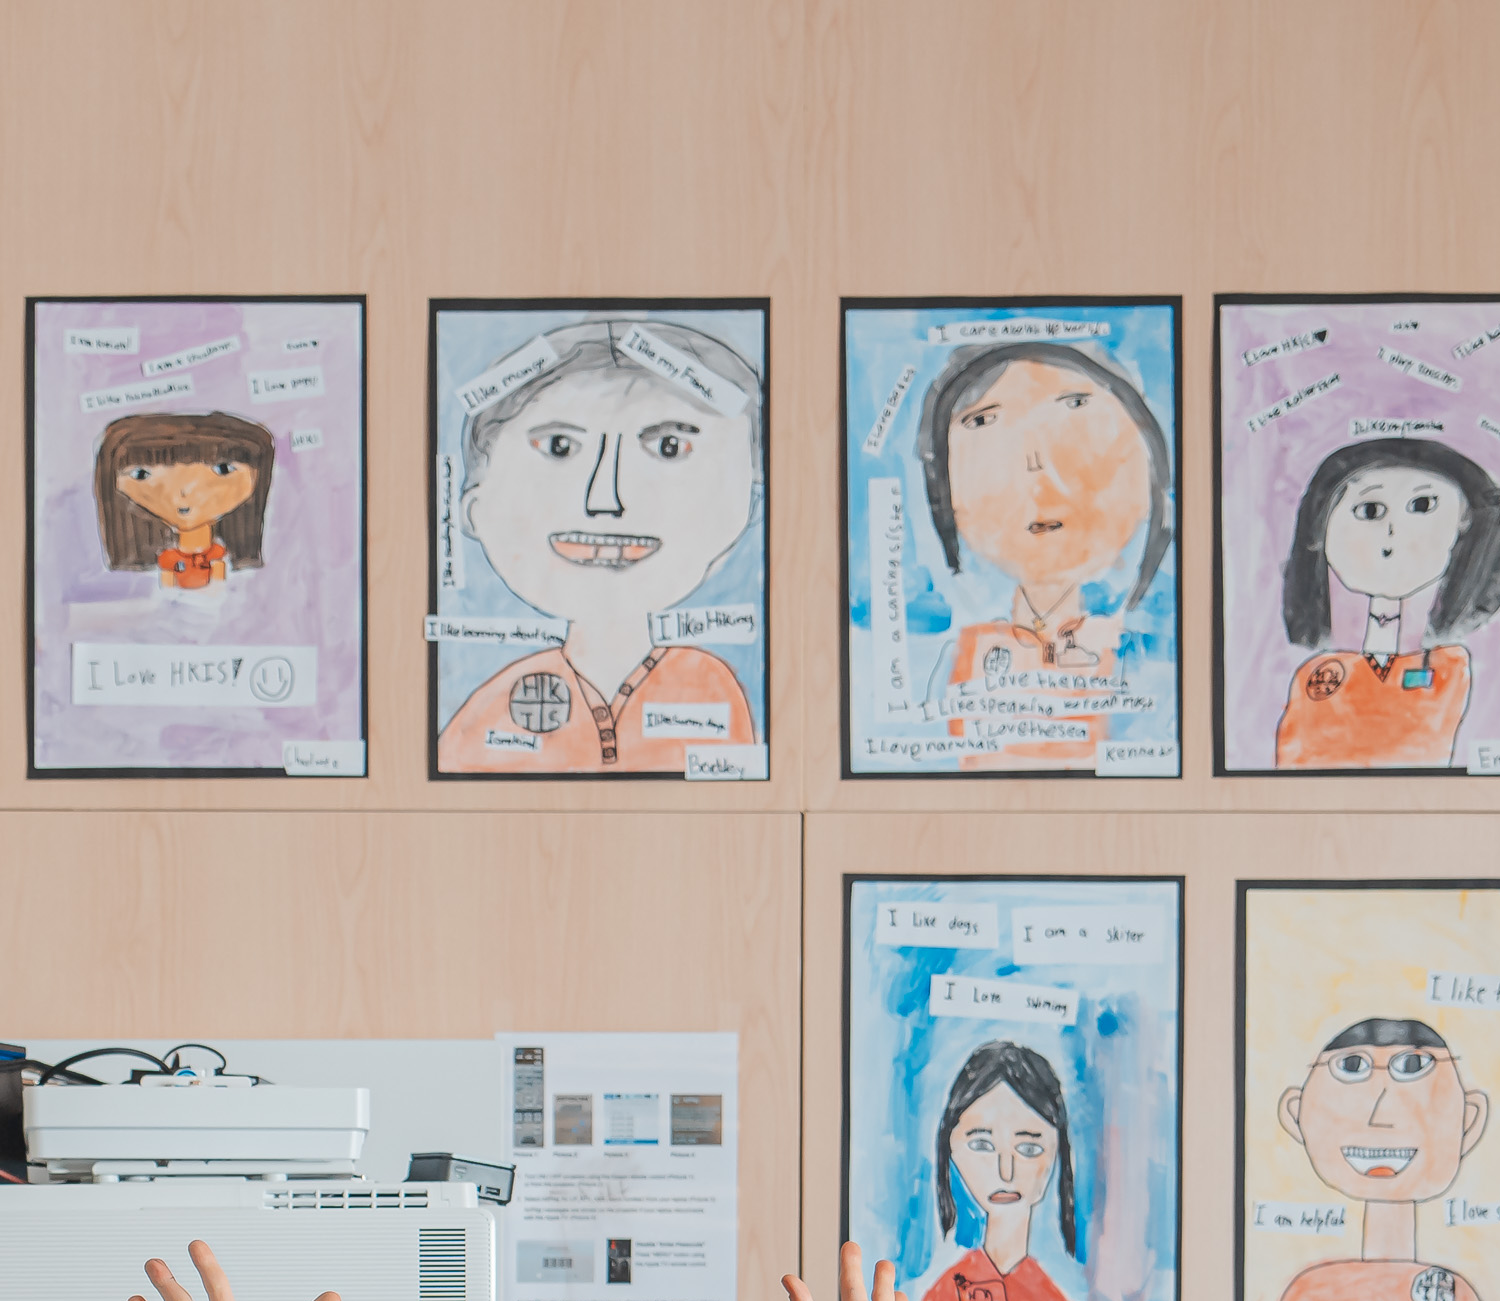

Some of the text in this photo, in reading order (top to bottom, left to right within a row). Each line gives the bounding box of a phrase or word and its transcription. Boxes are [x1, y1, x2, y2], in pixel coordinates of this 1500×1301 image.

[656, 611, 673, 640] I
[87, 661, 103, 691] I
[1431, 975, 1443, 1002] I
[1254, 1205, 1269, 1227] I
